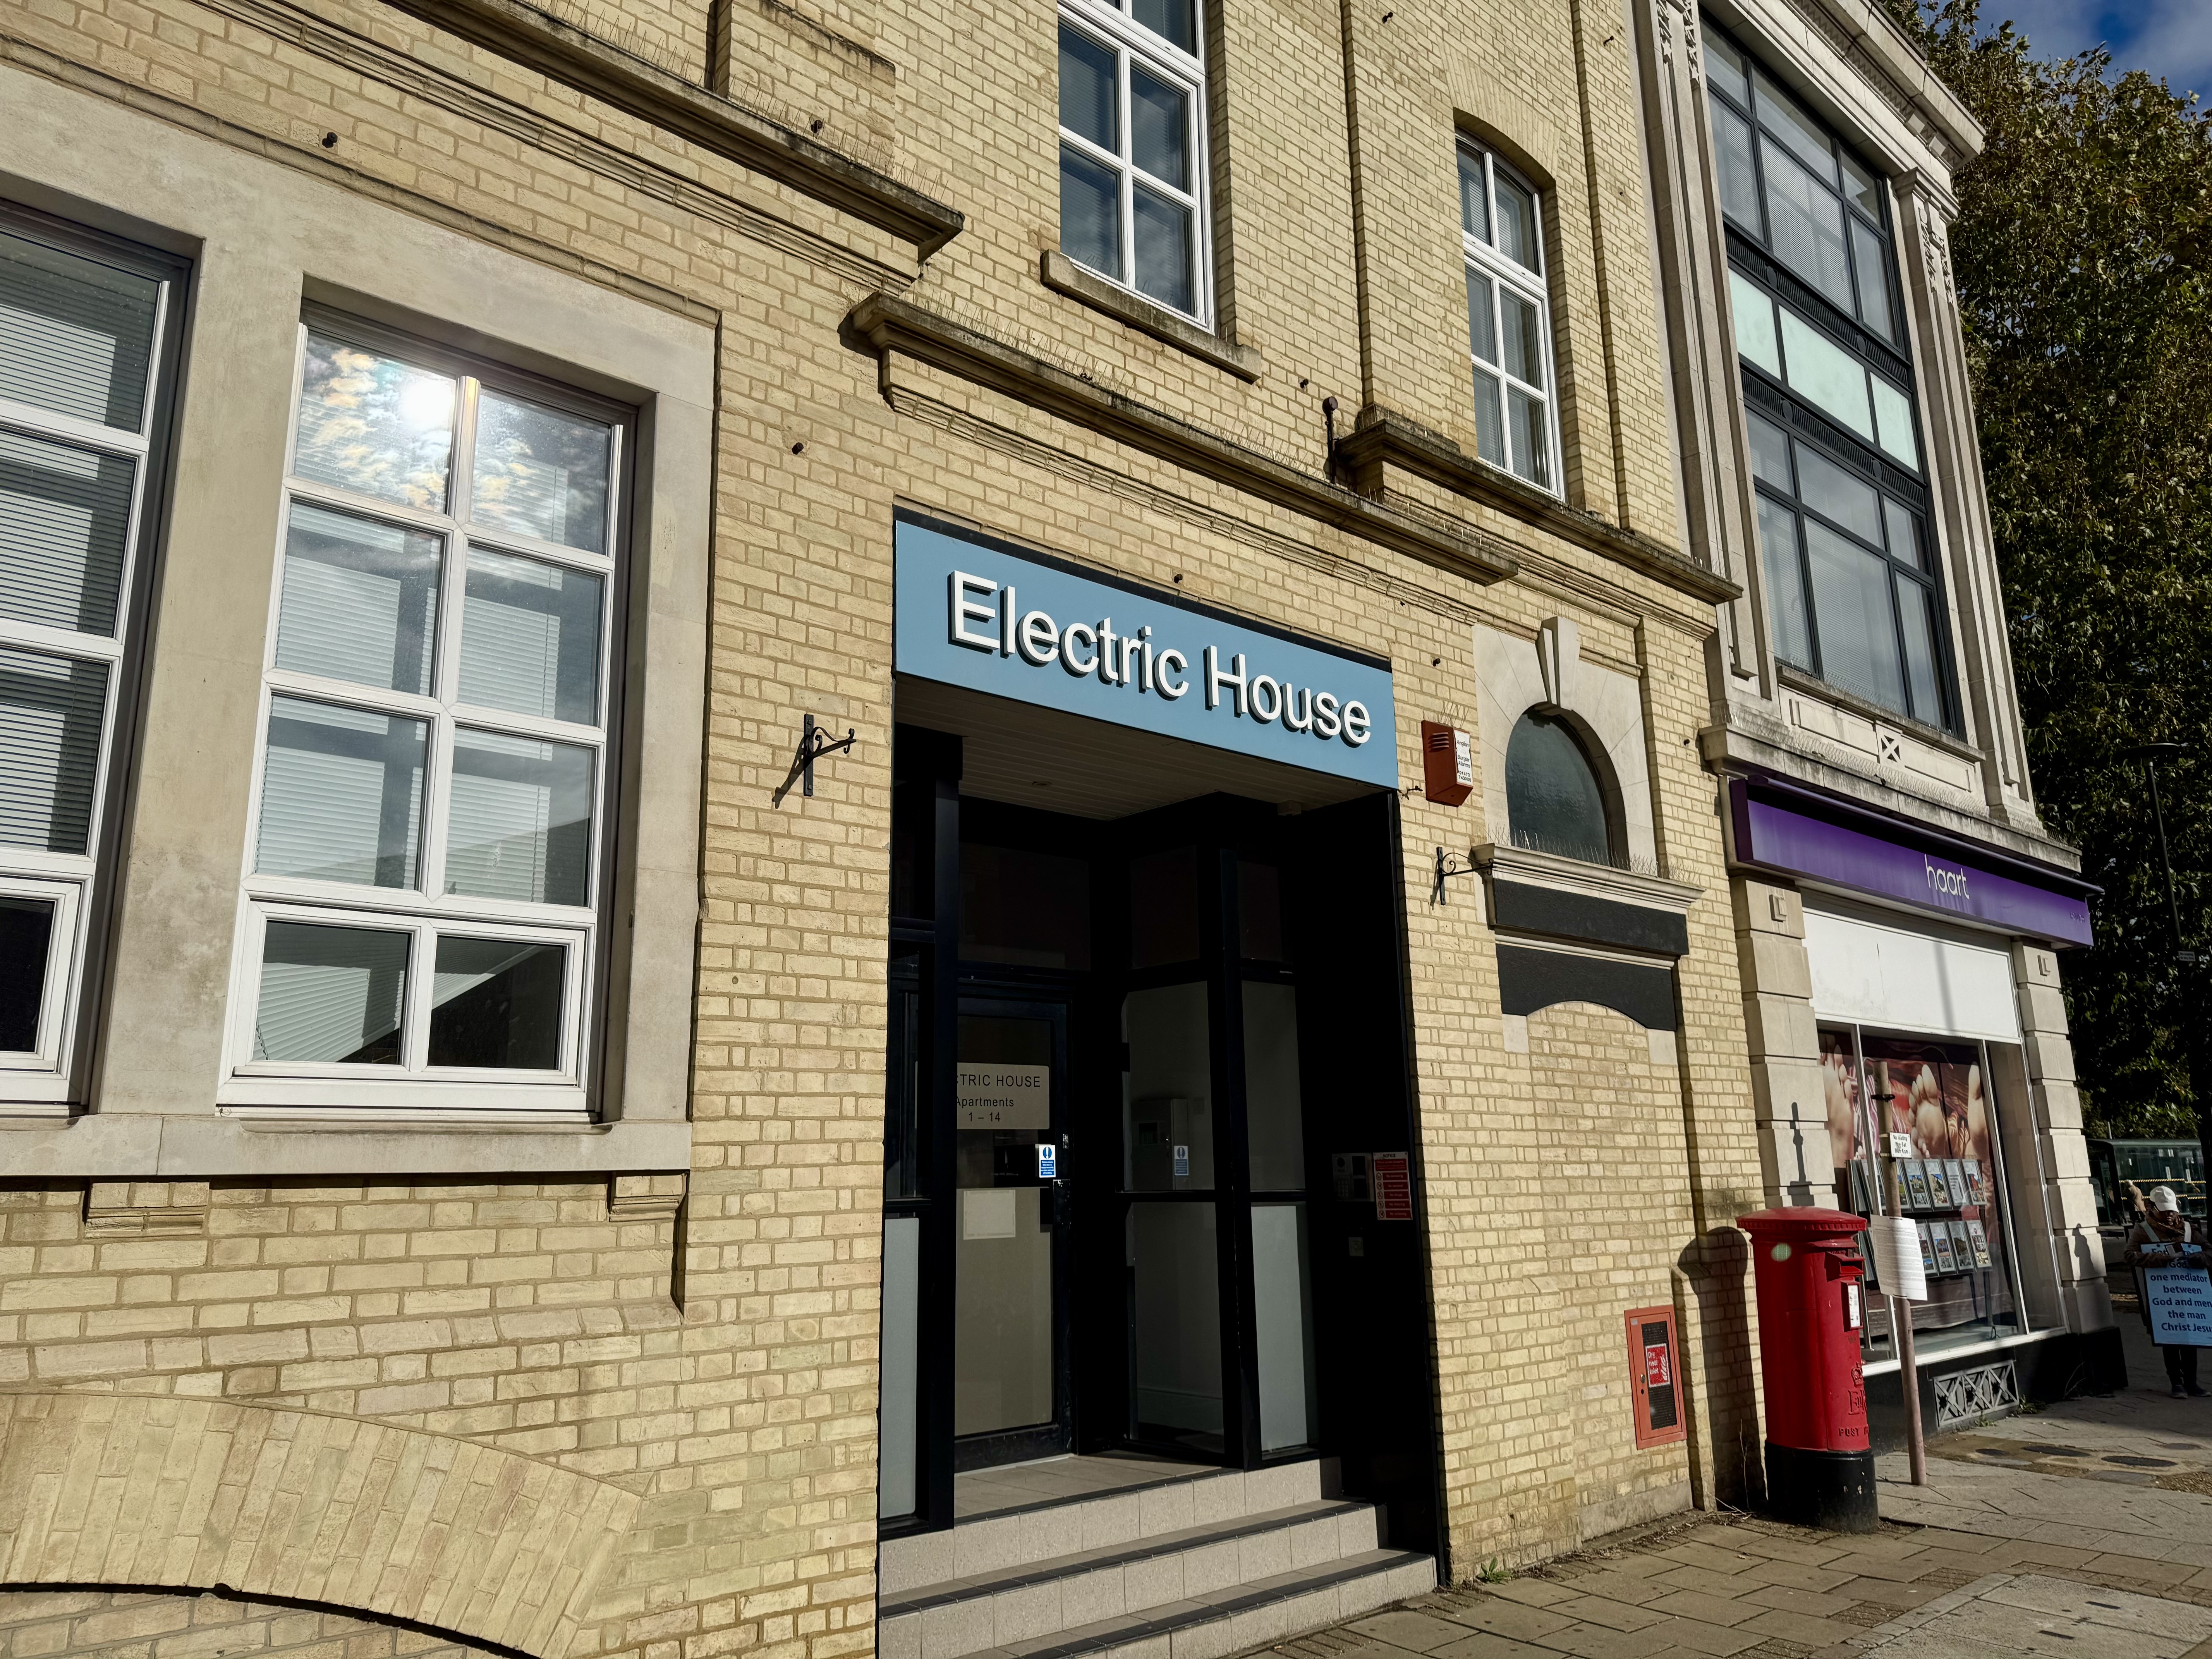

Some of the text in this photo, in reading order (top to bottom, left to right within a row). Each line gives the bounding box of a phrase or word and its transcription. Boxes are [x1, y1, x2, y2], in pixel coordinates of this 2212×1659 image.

[950, 570, 1372, 745] Electric House
[1457, 739, 1469, 747] Anglian
[1924, 854, 1970, 900] haart
[957, 1074, 1040, 1087] TRIC HOUSE
[969, 1112, 972, 1121] 1
[989, 1112, 1001, 1121] 14
[2170, 1273, 2207, 1283] mediator
[2163, 1285, 2202, 1294] between
[2152, 1297, 2172, 1305] God
[2175, 1298, 2193, 1306] and
[2167, 1310, 2185, 1318] the
[2161, 1322, 2212, 1333] Christ Jesu
[1838, 1427, 1859, 1437] POST
